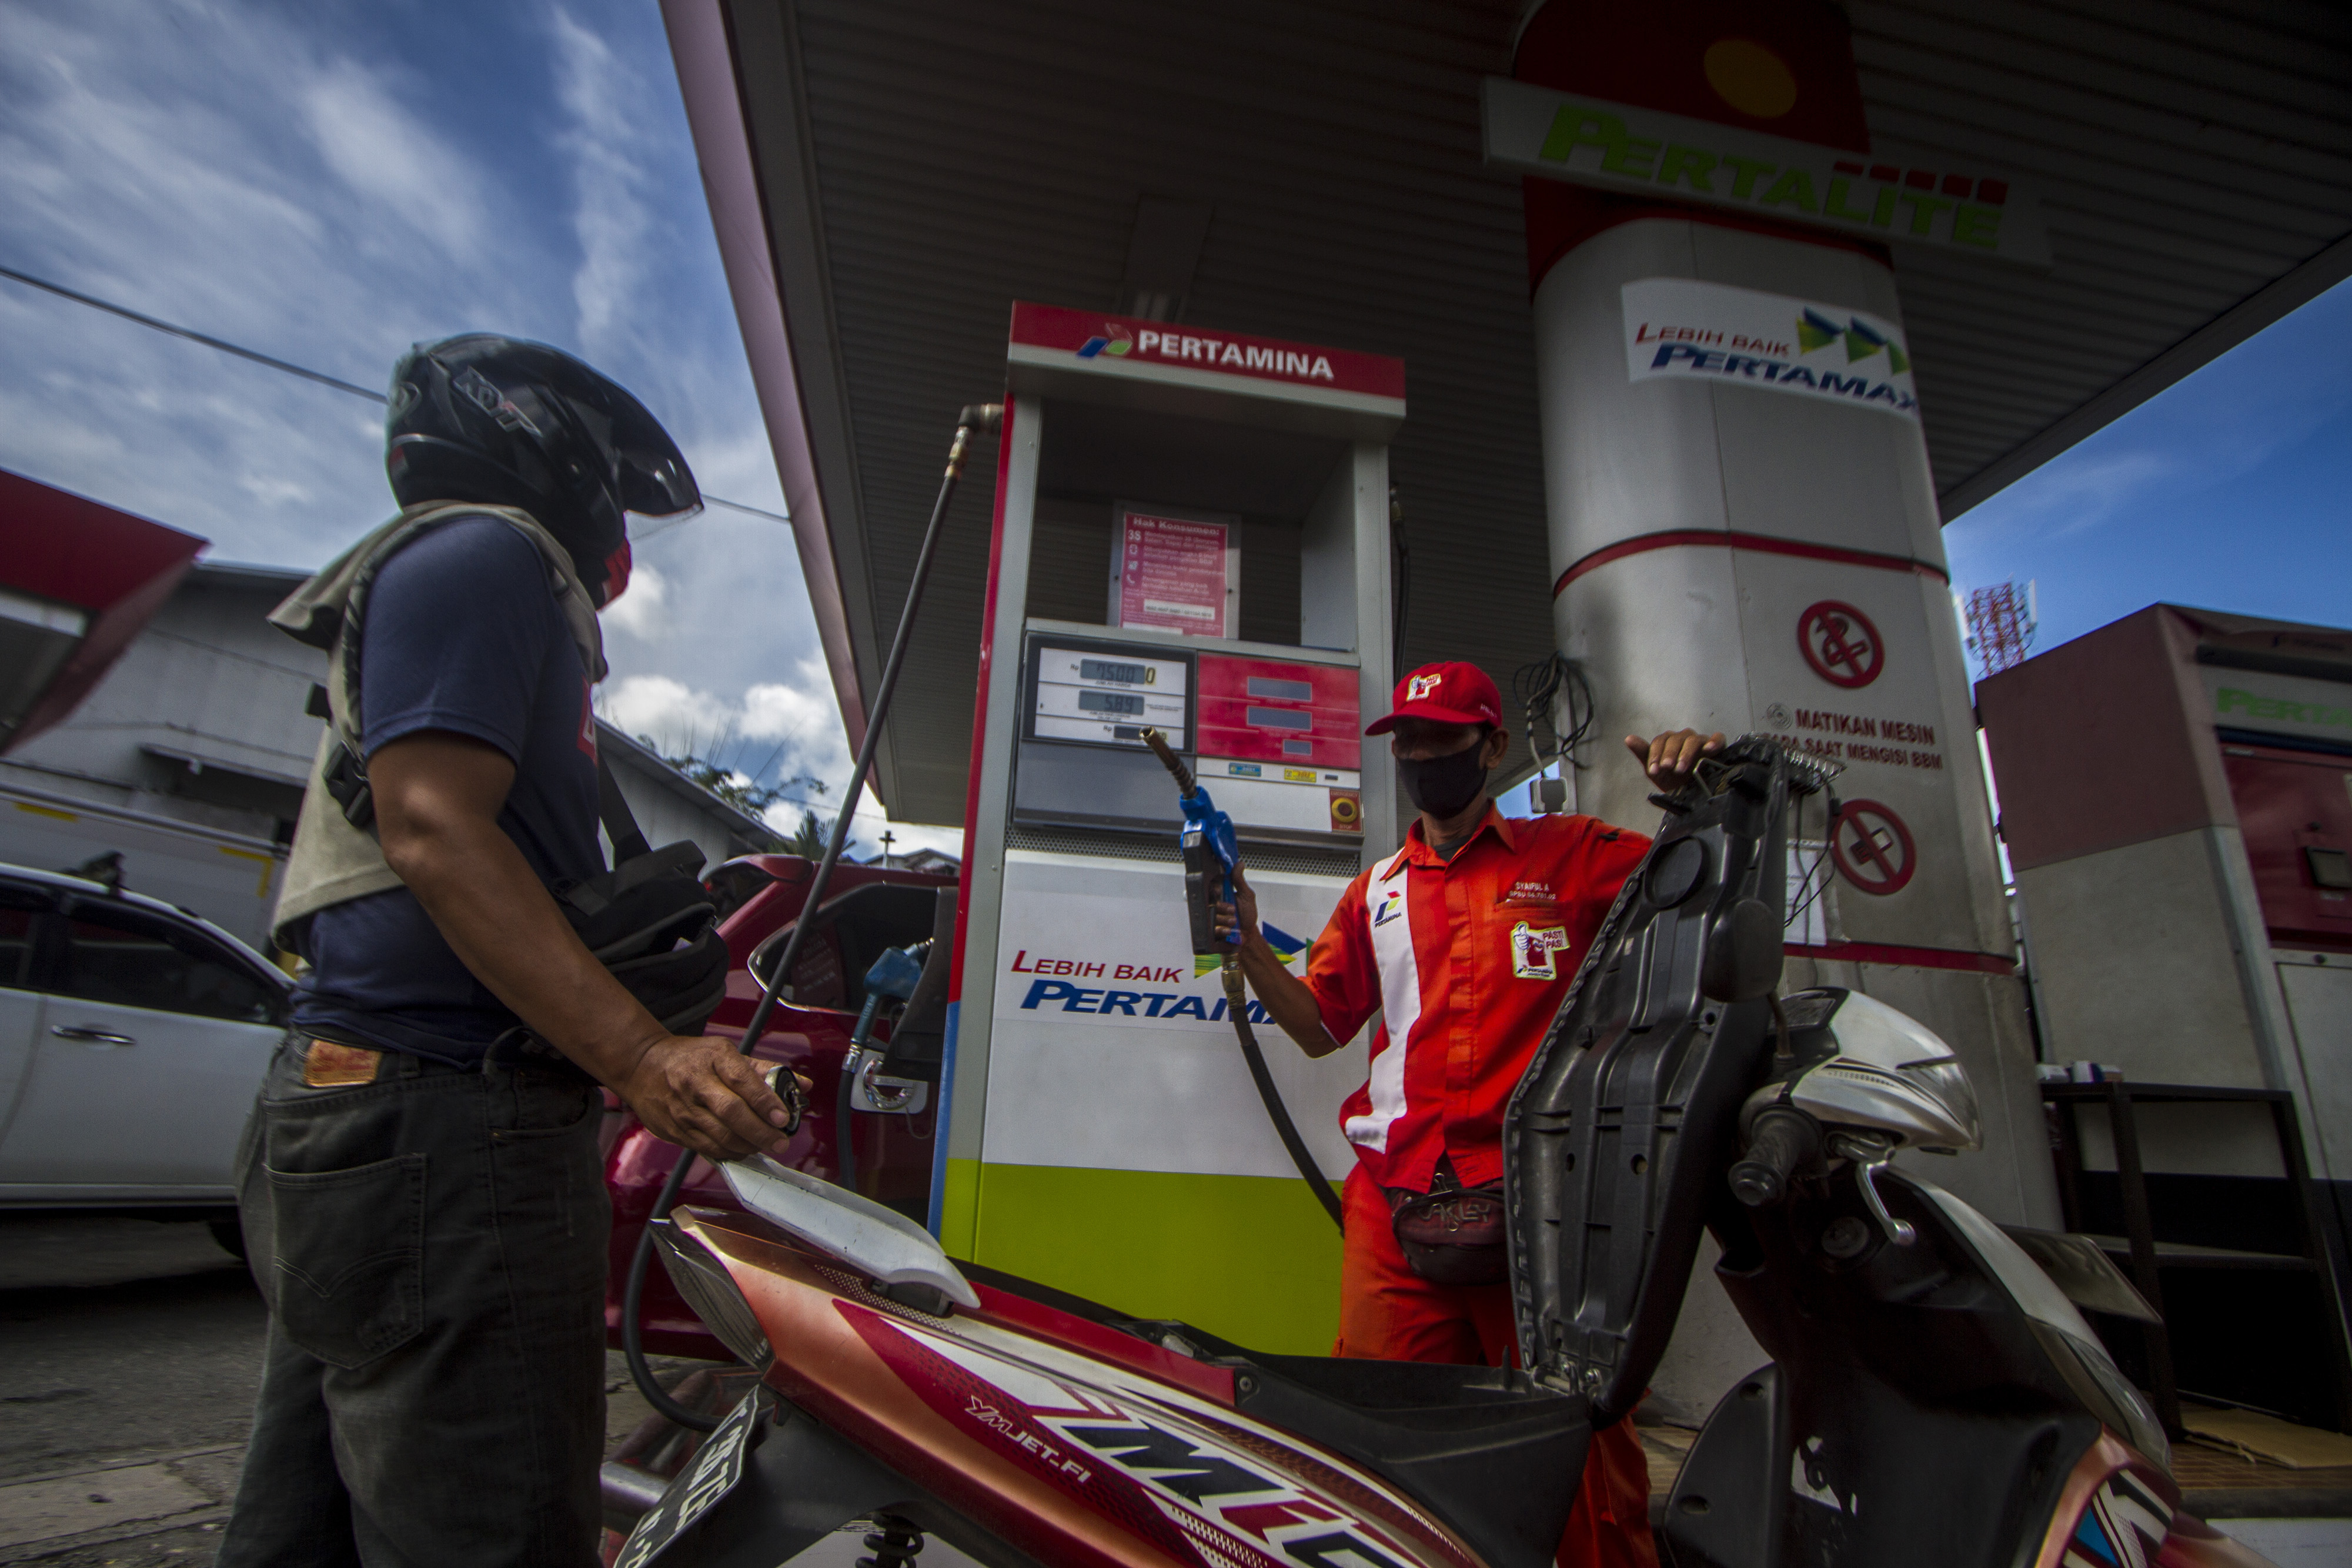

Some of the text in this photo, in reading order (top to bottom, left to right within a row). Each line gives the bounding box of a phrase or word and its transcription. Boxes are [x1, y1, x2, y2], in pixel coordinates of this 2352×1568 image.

[1539, 105, 2007, 250] PERTALITE
[1636, 323, 1790, 357] LEBIH BAIK
[1138, 330, 1334, 381] PERTAMINA
[1128, 529, 1141, 541] 3S
[1133, 517, 1155, 527] Hak
[1796, 708, 1936, 746] MATIKAN MESIN
[1846, 743, 1909, 766] MENGISI
[1911, 751, 1943, 770] BBM
[1509, 891, 1526, 899] SPBU
[1544, 883, 1549, 892] A
[1375, 912, 1402, 928] PERTAMINA
[1543, 930, 1563, 940] PASTI
[1011, 950, 1184, 984] LEBIH BAIK
[1020, 979, 1281, 1025] PERTAM
